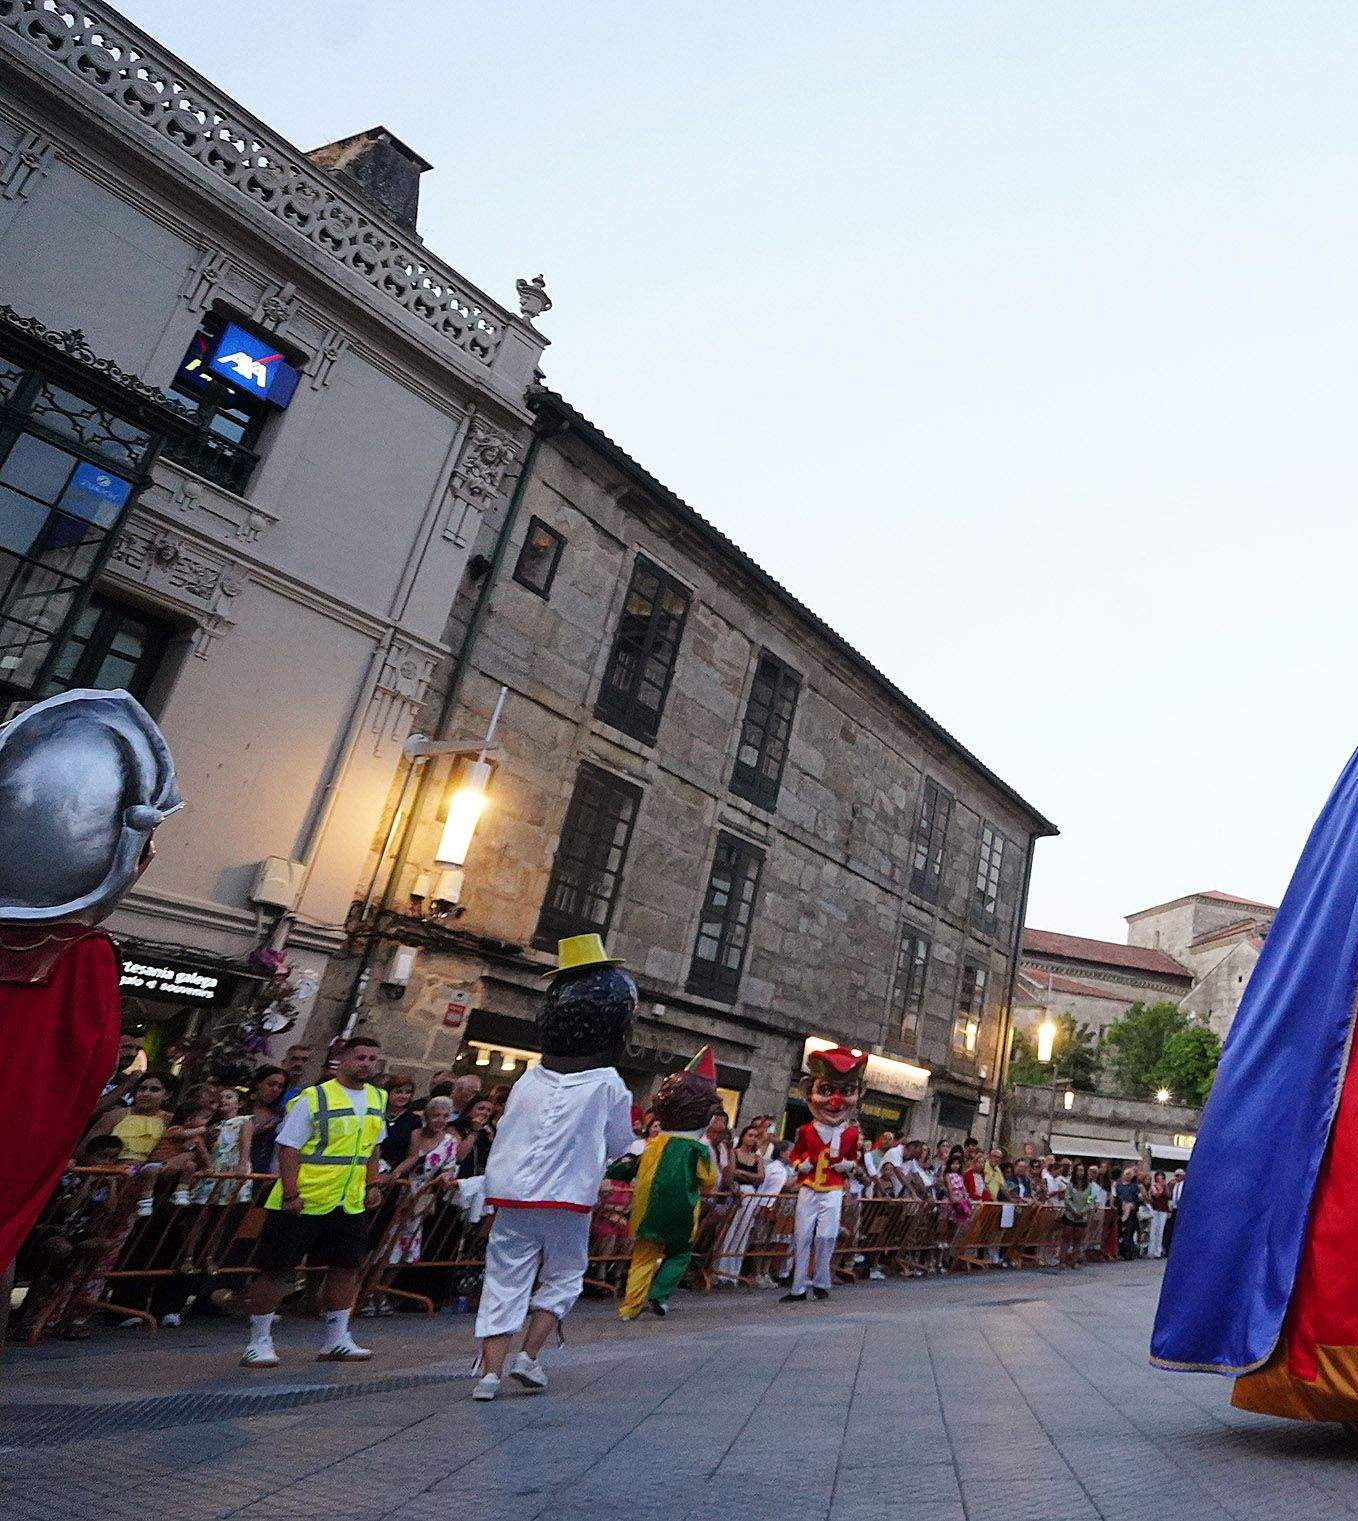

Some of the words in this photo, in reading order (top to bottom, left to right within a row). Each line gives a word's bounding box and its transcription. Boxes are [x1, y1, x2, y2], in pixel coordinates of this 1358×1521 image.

[217, 352, 282, 388] AXA
[122, 960, 175, 980] tesanía
[174, 972, 218, 989] galega
